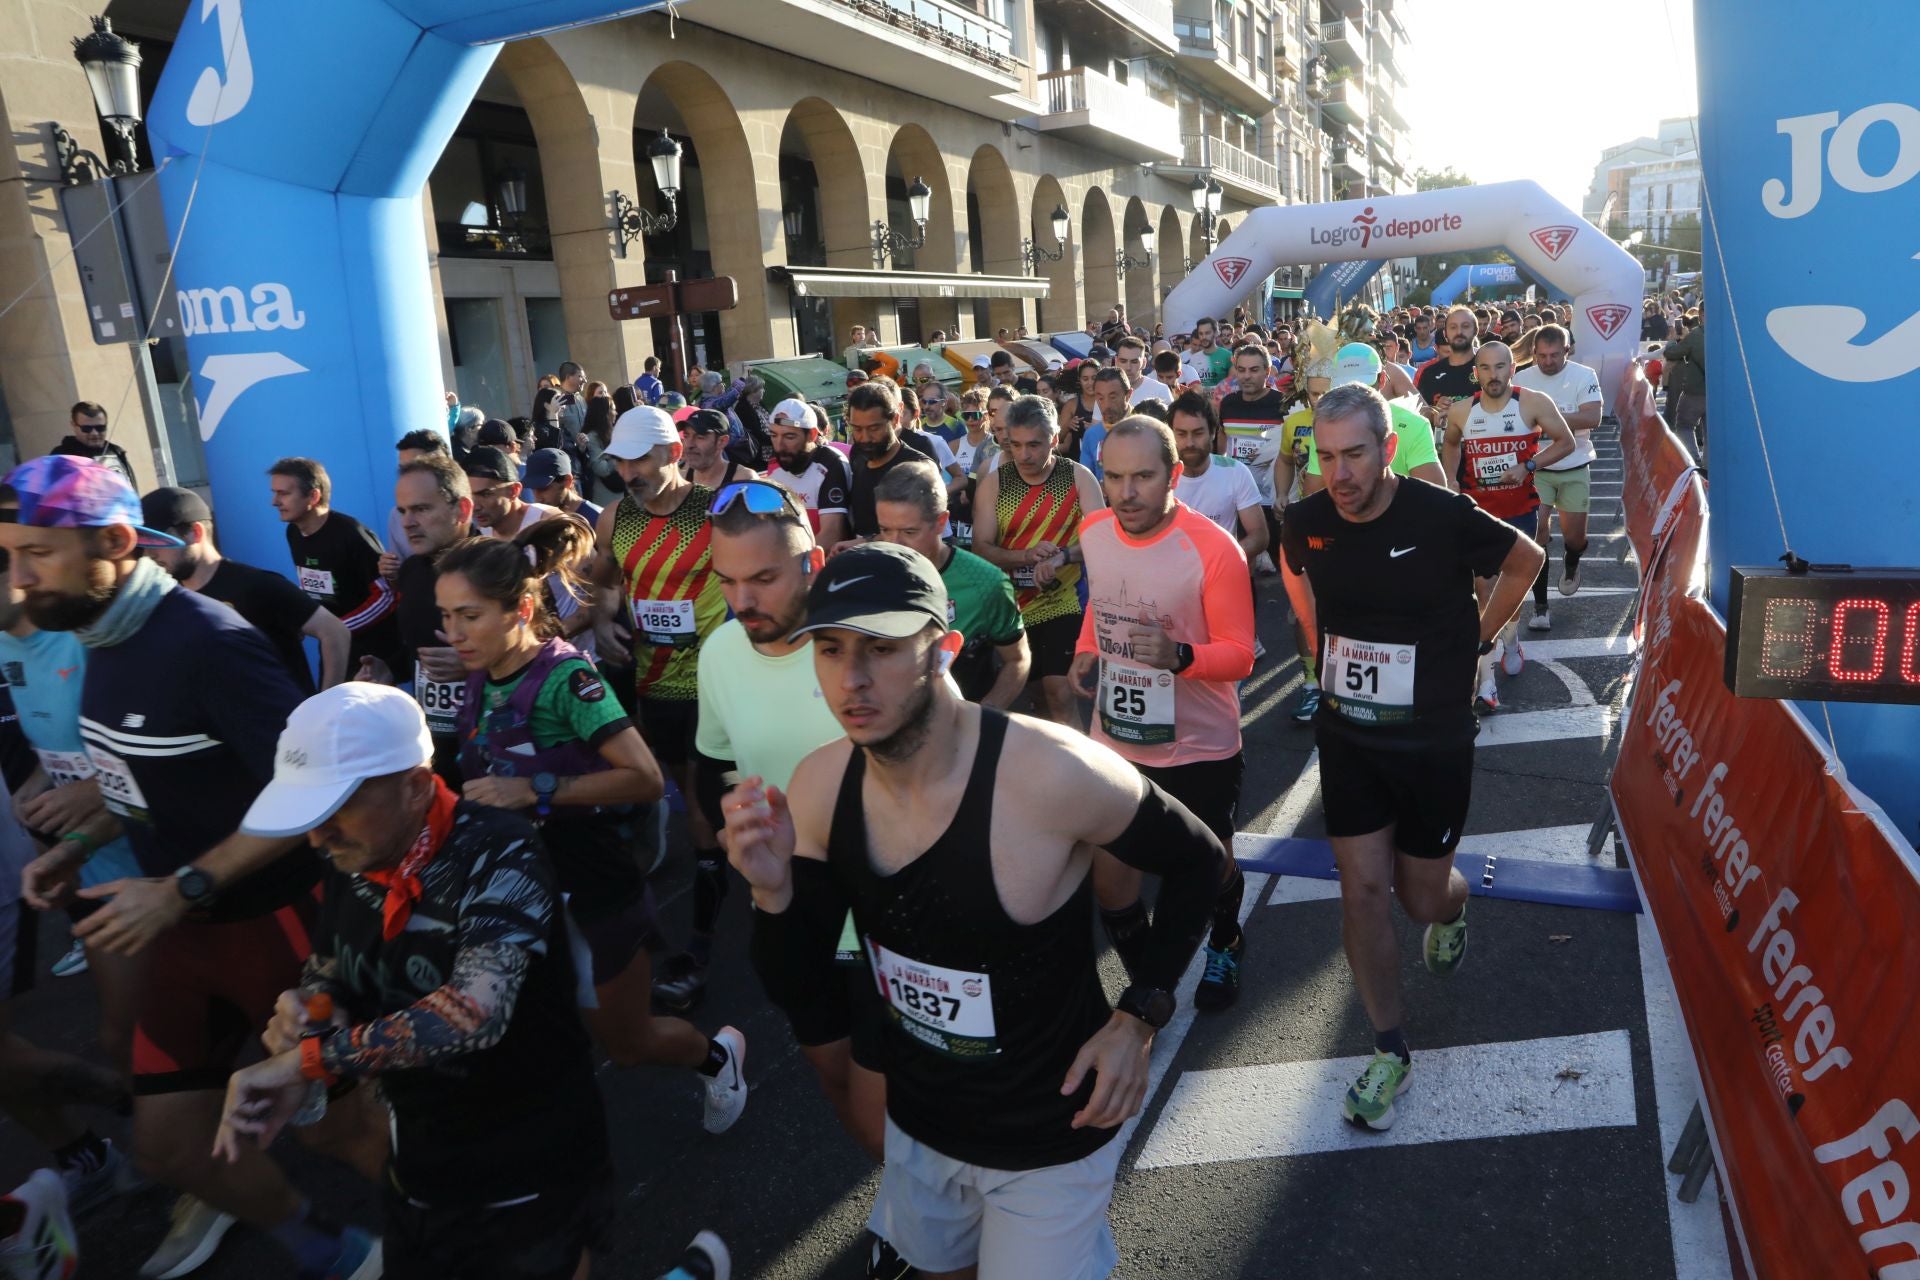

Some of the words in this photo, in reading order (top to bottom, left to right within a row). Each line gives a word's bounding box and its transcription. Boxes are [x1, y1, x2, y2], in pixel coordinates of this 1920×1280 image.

[1386, 213, 1462, 239] deporte
[1480, 266, 1517, 276] POWER
[177, 282, 305, 336] oma
[1237, 446, 1257, 456] 153
[1482, 463, 1509, 474] 1940
[303, 577, 326, 589] 2024
[642, 613, 682, 627] 1863
[1342, 646, 1350, 657] LA
[1351, 649, 1391, 665] MARATÓN
[1110, 670, 1116, 681] LA
[1118, 672, 1152, 688] MARATÓN
[1345, 661, 1379, 695] 51
[1113, 685, 1146, 716] 25
[1647, 679, 1700, 780] ferrer
[1690, 762, 1762, 898] ferrer
[904, 970, 950, 993] MARATÓN
[1747, 886, 1853, 1082] ferrer
[889, 977, 961, 1021] 1837
